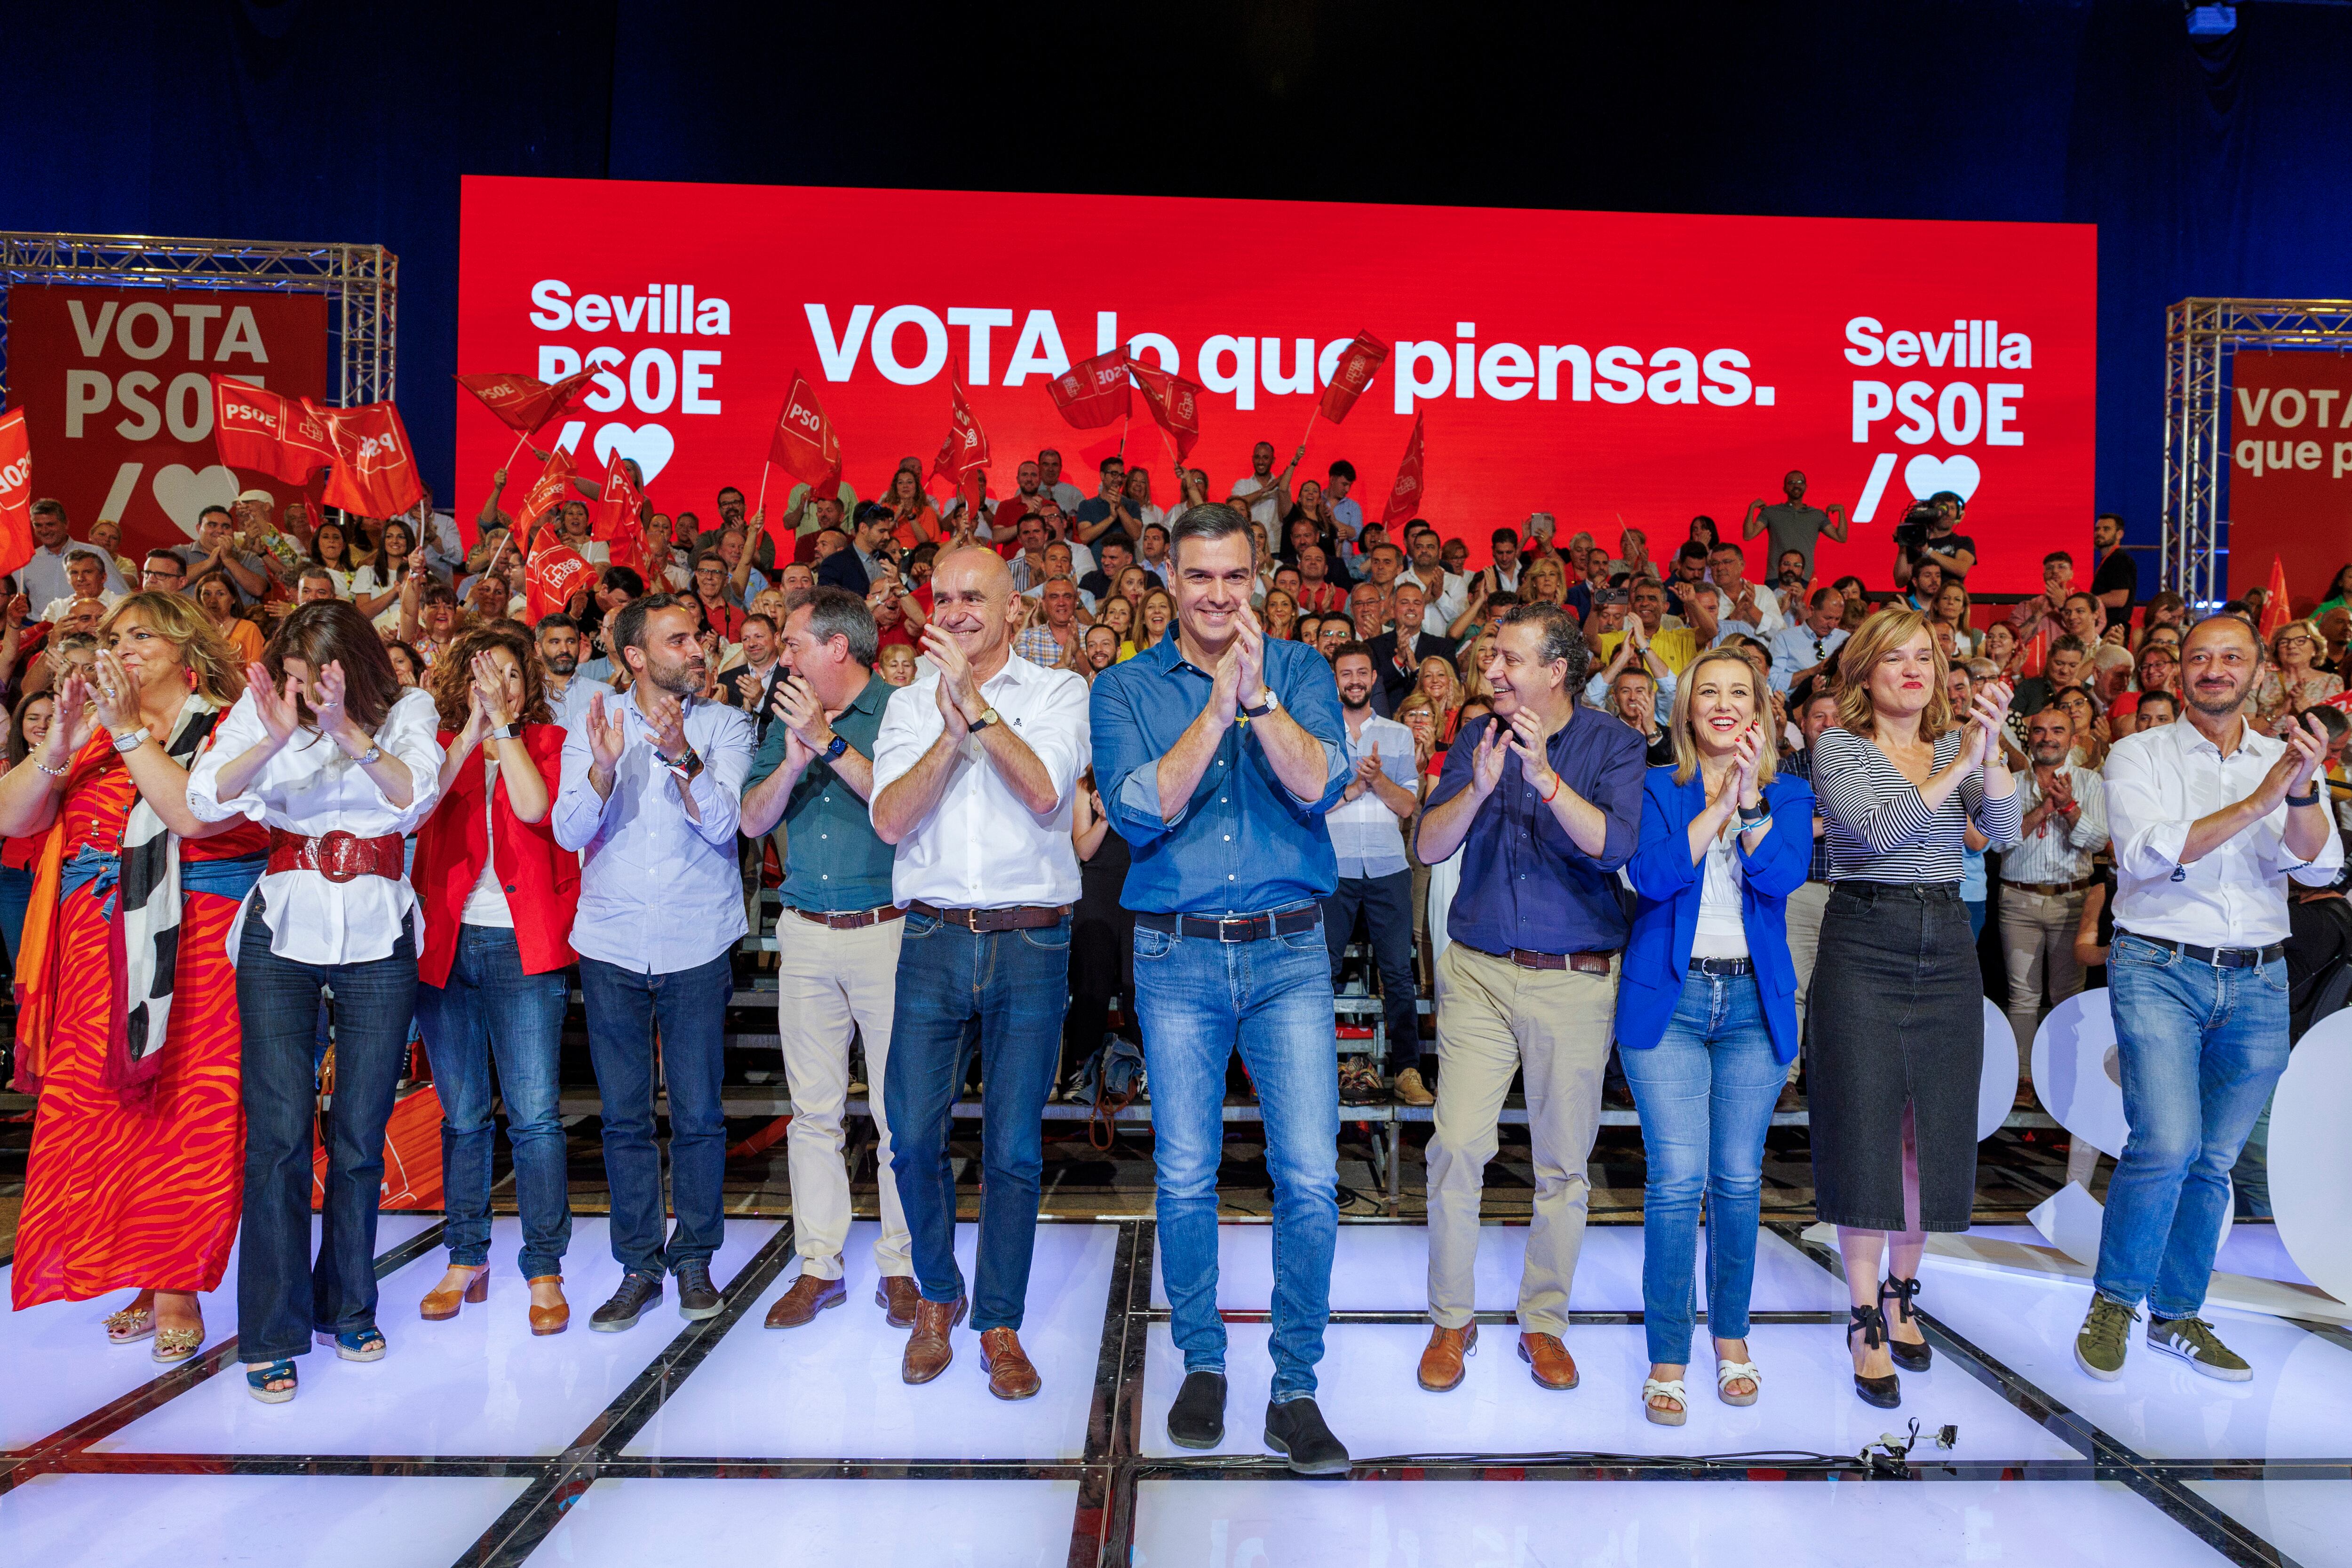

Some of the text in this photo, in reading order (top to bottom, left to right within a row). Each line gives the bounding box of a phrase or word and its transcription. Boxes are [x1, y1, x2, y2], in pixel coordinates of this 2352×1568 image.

[67, 300, 269, 363] VOTA
[529, 279, 731, 335] Sevilla
[803, 303, 1071, 387] VOTA
[1394, 322, 1775, 415] piensas.
[1844, 316, 2032, 369] Sevilla
[66, 370, 264, 443] PSO
[225, 404, 277, 428] PSOE
[789, 403, 820, 431] PSO
[1852, 380, 2024, 446] PSOE
[2235, 439, 2322, 477] que
